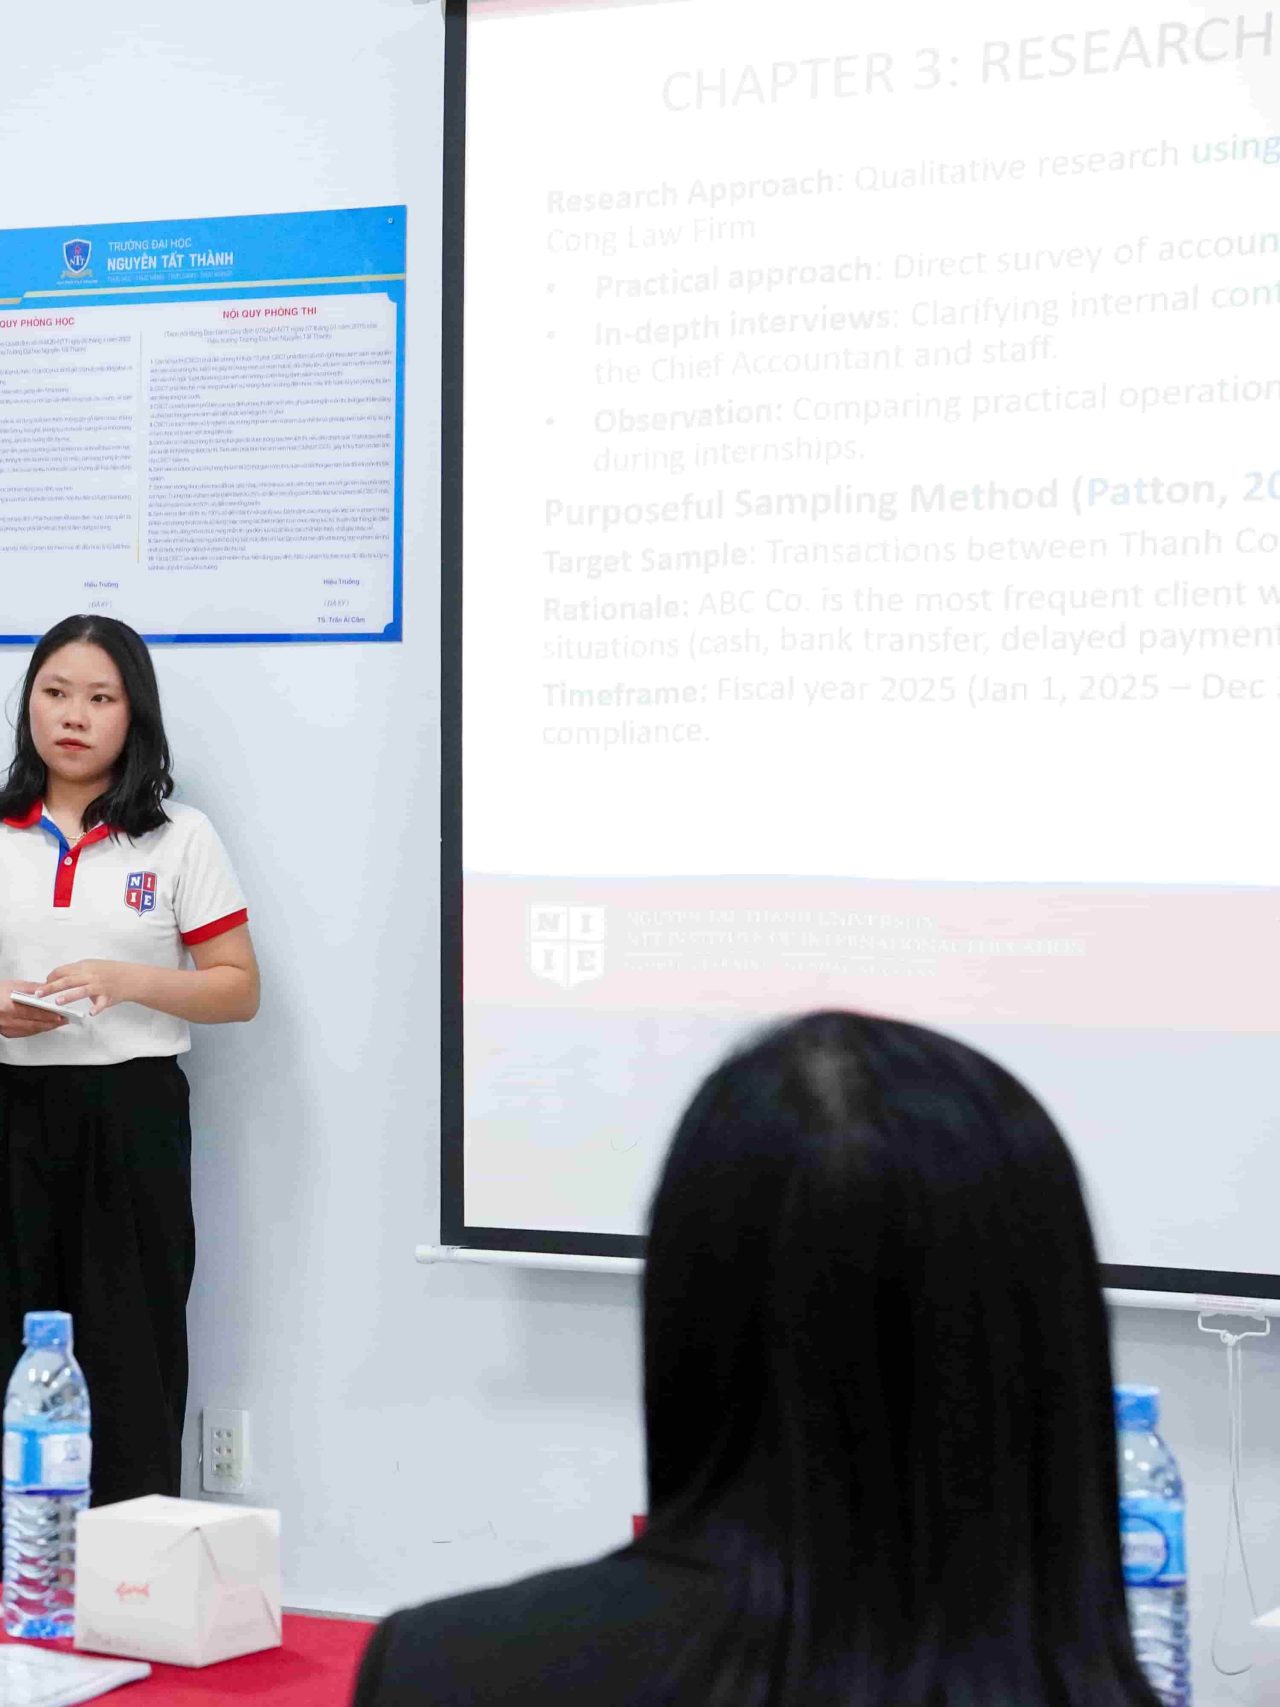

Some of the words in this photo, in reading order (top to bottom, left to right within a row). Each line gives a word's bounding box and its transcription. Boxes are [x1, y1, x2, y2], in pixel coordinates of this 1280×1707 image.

[662, 53, 894, 111] CHAPTER
[914, 48, 958, 89] 3:
[982, 11, 1273, 83] RESEARCH
[548, 182, 677, 213] Research
[688, 168, 843, 208] Approach:
[855, 160, 1026, 191] Qualitative
[1039, 140, 1178, 176] research
[1192, 131, 1280, 167] using
[548, 229, 616, 256] Cong
[629, 226, 682, 248] Law
[694, 217, 754, 242] Firm
[162, 251, 185, 268] TẤT
[190, 249, 234, 267] THÀNH
[596, 266, 718, 299] Practical
[729, 256, 881, 293] approach:
[895, 252, 986, 279] Direct
[998, 248, 1102, 273] survey
[1114, 236, 1149, 265] of
[0, 319, 18, 329] QUY
[20, 316, 53, 328] PHÒNG
[55, 317, 76, 327] HỌC
[242, 309, 261, 318] QUY
[264, 306, 299, 317] PHÒNG
[302, 306, 317, 315] THI
[596, 314, 719, 348] In-depth
[731, 305, 898, 336] interviews:
[912, 296, 1058, 328] Clarifying
[1072, 284, 1198, 317] internal
[596, 360, 640, 384] the
[652, 354, 723, 382] Chief
[732, 345, 904, 375] Accountant
[915, 339, 971, 367] and
[983, 335, 1056, 363] staff.
[595, 399, 782, 432] Observation:
[794, 392, 961, 425] Comparing
[973, 383, 1106, 421] practical
[594, 447, 685, 475] during
[696, 437, 864, 466] internships.
[546, 490, 723, 533] Purposeful
[736, 484, 898, 522] Sampling
[911, 478, 1058, 512] Method
[1072, 475, 1227, 516] (Patton,
[542, 550, 632, 580] Target
[642, 542, 754, 574] Sample:
[767, 536, 956, 564] Transactions
[968, 536, 1107, 562] between
[1120, 529, 1222, 557] Thanh
[544, 594, 688, 621] Rationale:
[698, 590, 754, 615] ABC
[766, 589, 809, 612] Co.
[822, 587, 842, 611] is
[854, 587, 904, 612] the
[916, 589, 992, 612] most
[1004, 584, 1144, 616] frequent
[1155, 580, 1246, 608] client
[544, 635, 678, 659] situations
[690, 628, 768, 660] (cash,
[781, 626, 852, 651] bank
[864, 626, 989, 656] transfer,
[1002, 622, 1126, 656] delayed
[542, 680, 706, 707] Timeframe:
[718, 676, 794, 700] Fiscal
[804, 681, 869, 706] year
[880, 676, 955, 702] 2025
[969, 674, 1027, 708] (Jan
[1043, 676, 1067, 706] 1,
[1080, 673, 1159, 700] 2025
[1202, 673, 1265, 700] Dec
[543, 720, 709, 751] compliance.
